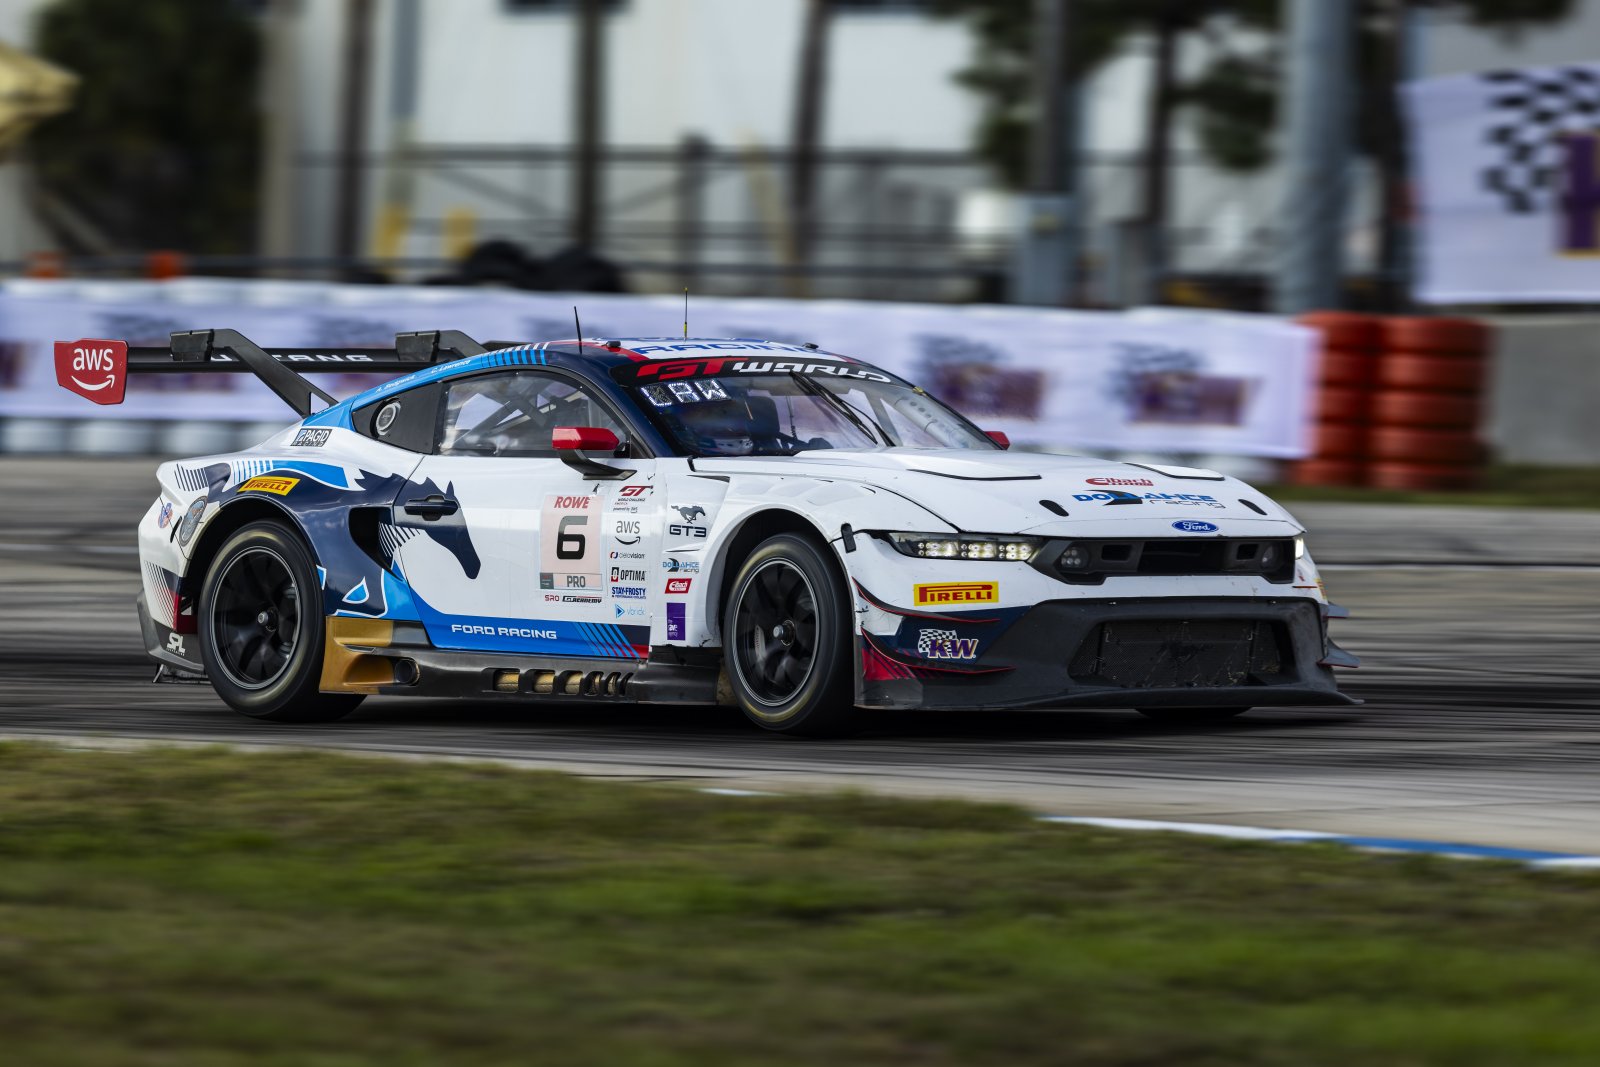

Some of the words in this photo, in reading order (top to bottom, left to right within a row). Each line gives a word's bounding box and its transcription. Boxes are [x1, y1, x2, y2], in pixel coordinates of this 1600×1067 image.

[73, 348, 114, 371] aws
[732, 362, 892, 383] WORLD
[641, 380, 727, 406] LAW
[303, 430, 329, 441] PAGID
[244, 480, 293, 491] PIRELLI
[554, 497, 590, 508] ROWE
[1150, 500, 1226, 509] racing
[616, 520, 640, 534] aws
[670, 525, 706, 537] GT3
[1183, 521, 1211, 531] Ford
[556, 516, 588, 560] 6
[567, 576, 586, 587] PRO
[620, 570, 646, 581] OPTIMA
[919, 584, 993, 602] PIRELLI
[452, 625, 495, 635] FORD
[498, 628, 557, 639] RACING
[928, 639, 979, 659] KW
